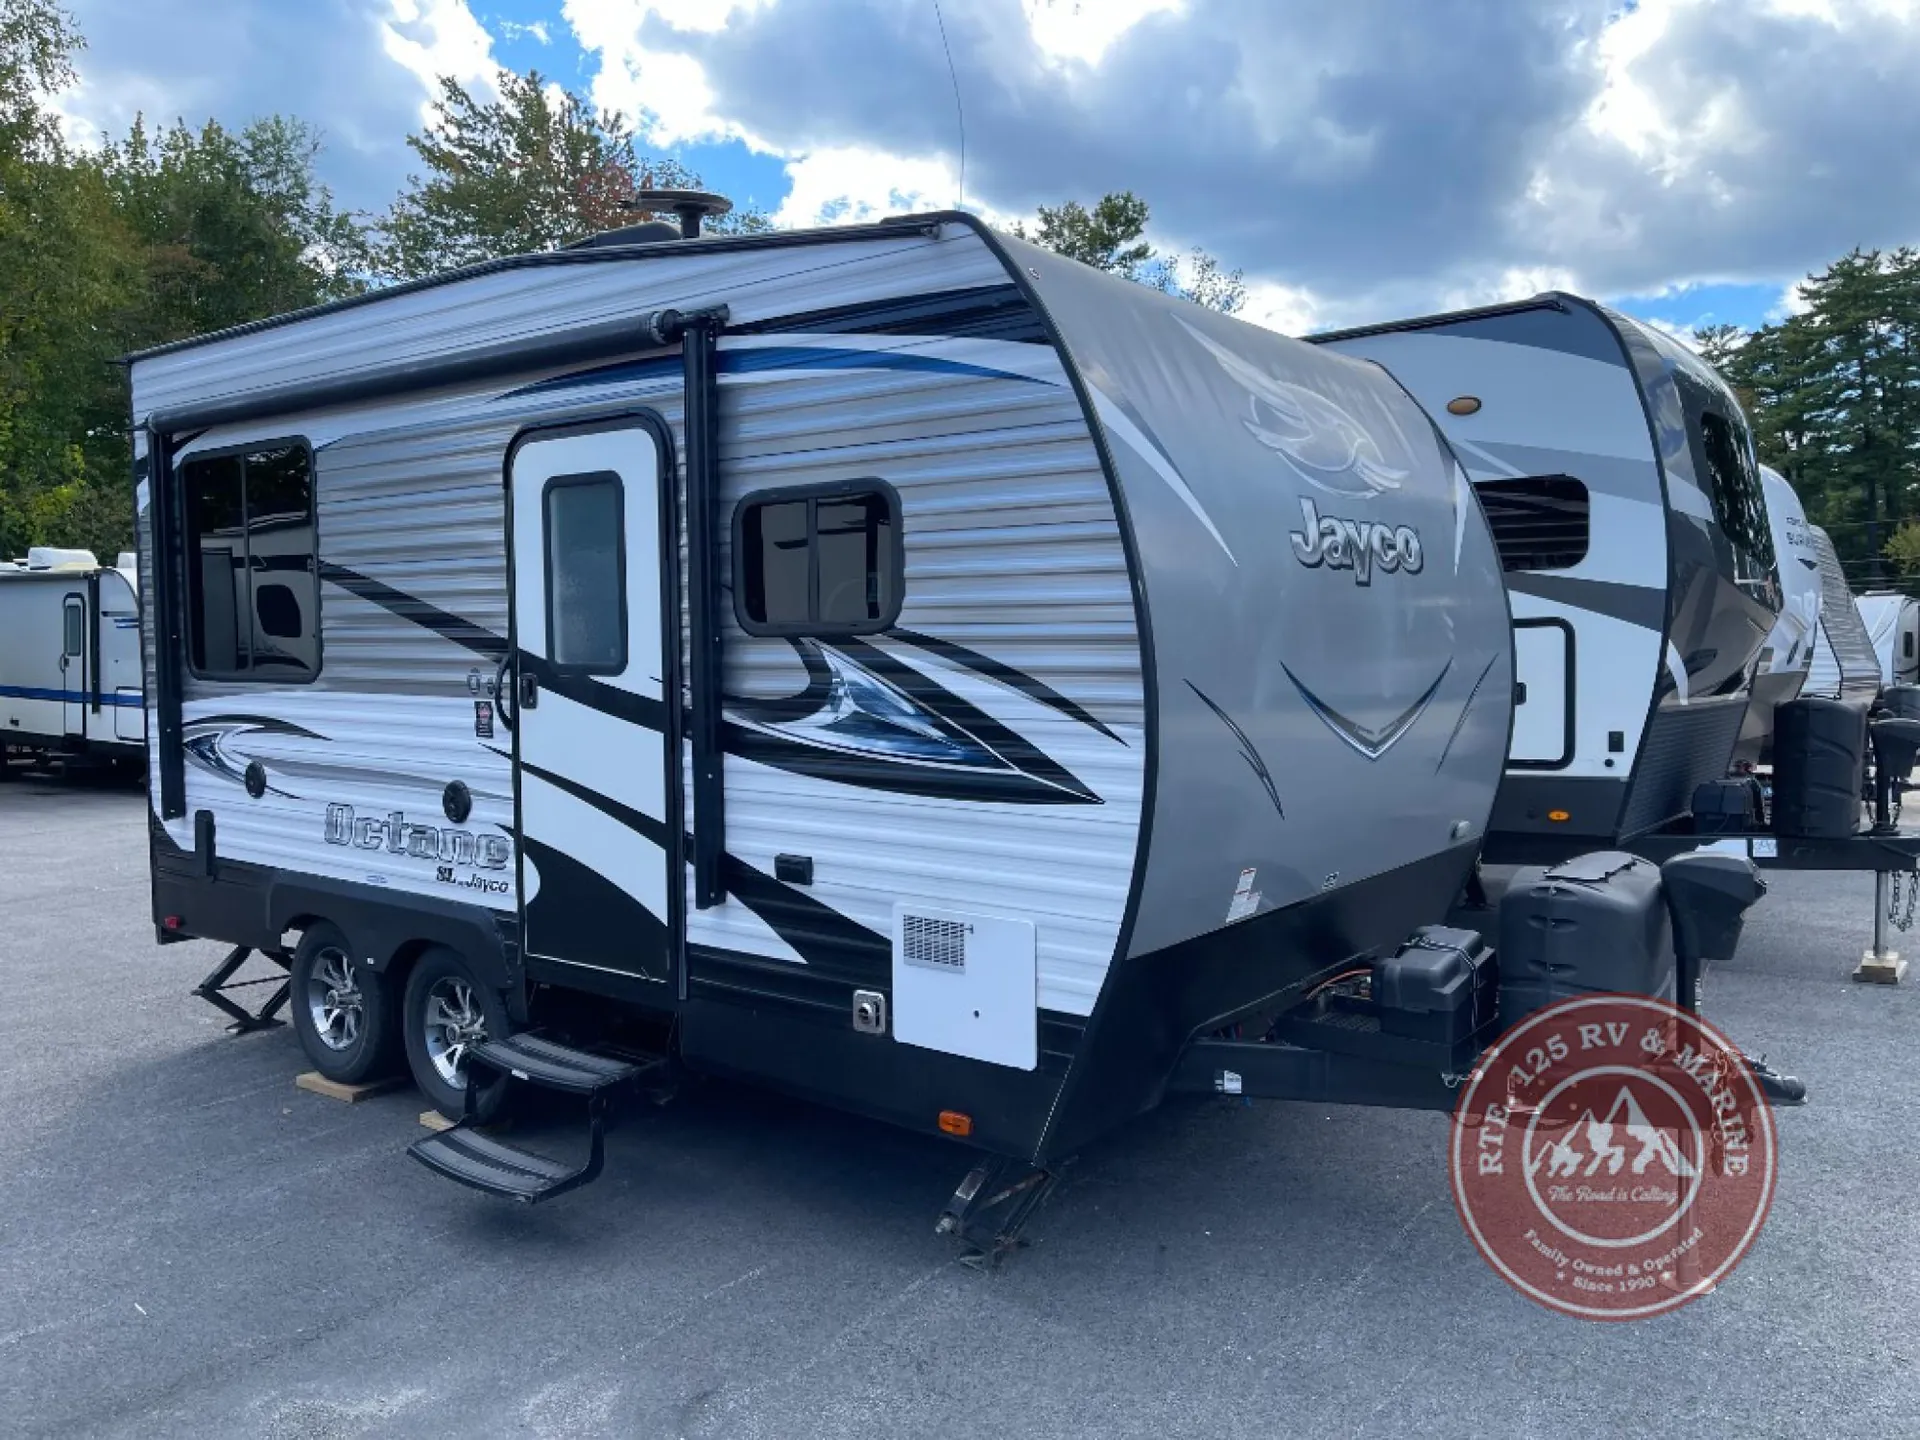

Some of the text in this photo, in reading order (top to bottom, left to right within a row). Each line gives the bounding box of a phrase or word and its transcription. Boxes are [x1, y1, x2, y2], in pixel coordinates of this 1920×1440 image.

[1290, 495, 1423, 587] Jayco
[324, 802, 510, 870] Octane
[466, 873, 509, 893] Jayco
